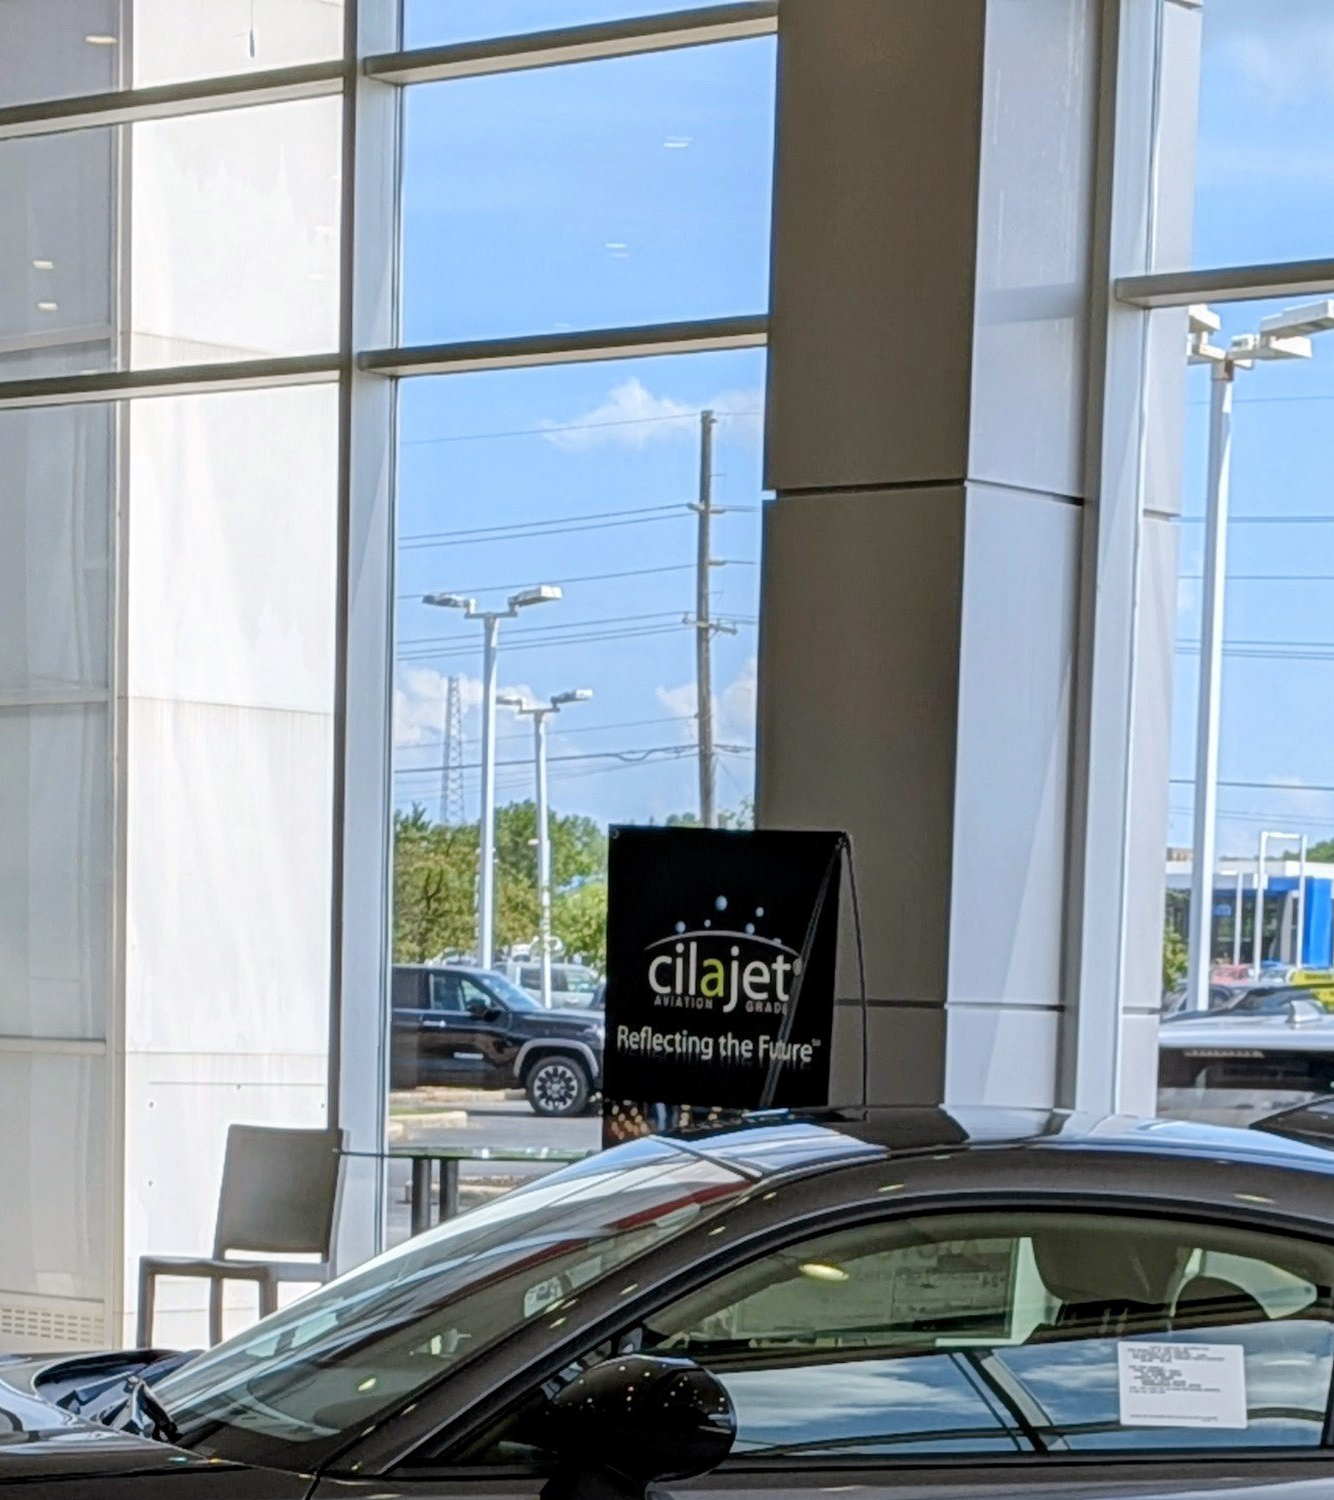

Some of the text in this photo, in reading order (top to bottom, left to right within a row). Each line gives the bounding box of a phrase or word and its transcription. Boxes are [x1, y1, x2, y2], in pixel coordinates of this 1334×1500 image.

[654, 996, 713, 1010] AVIATION
[617, 1025, 714, 1061] Reflecting
[718, 1032, 754, 1059] the
